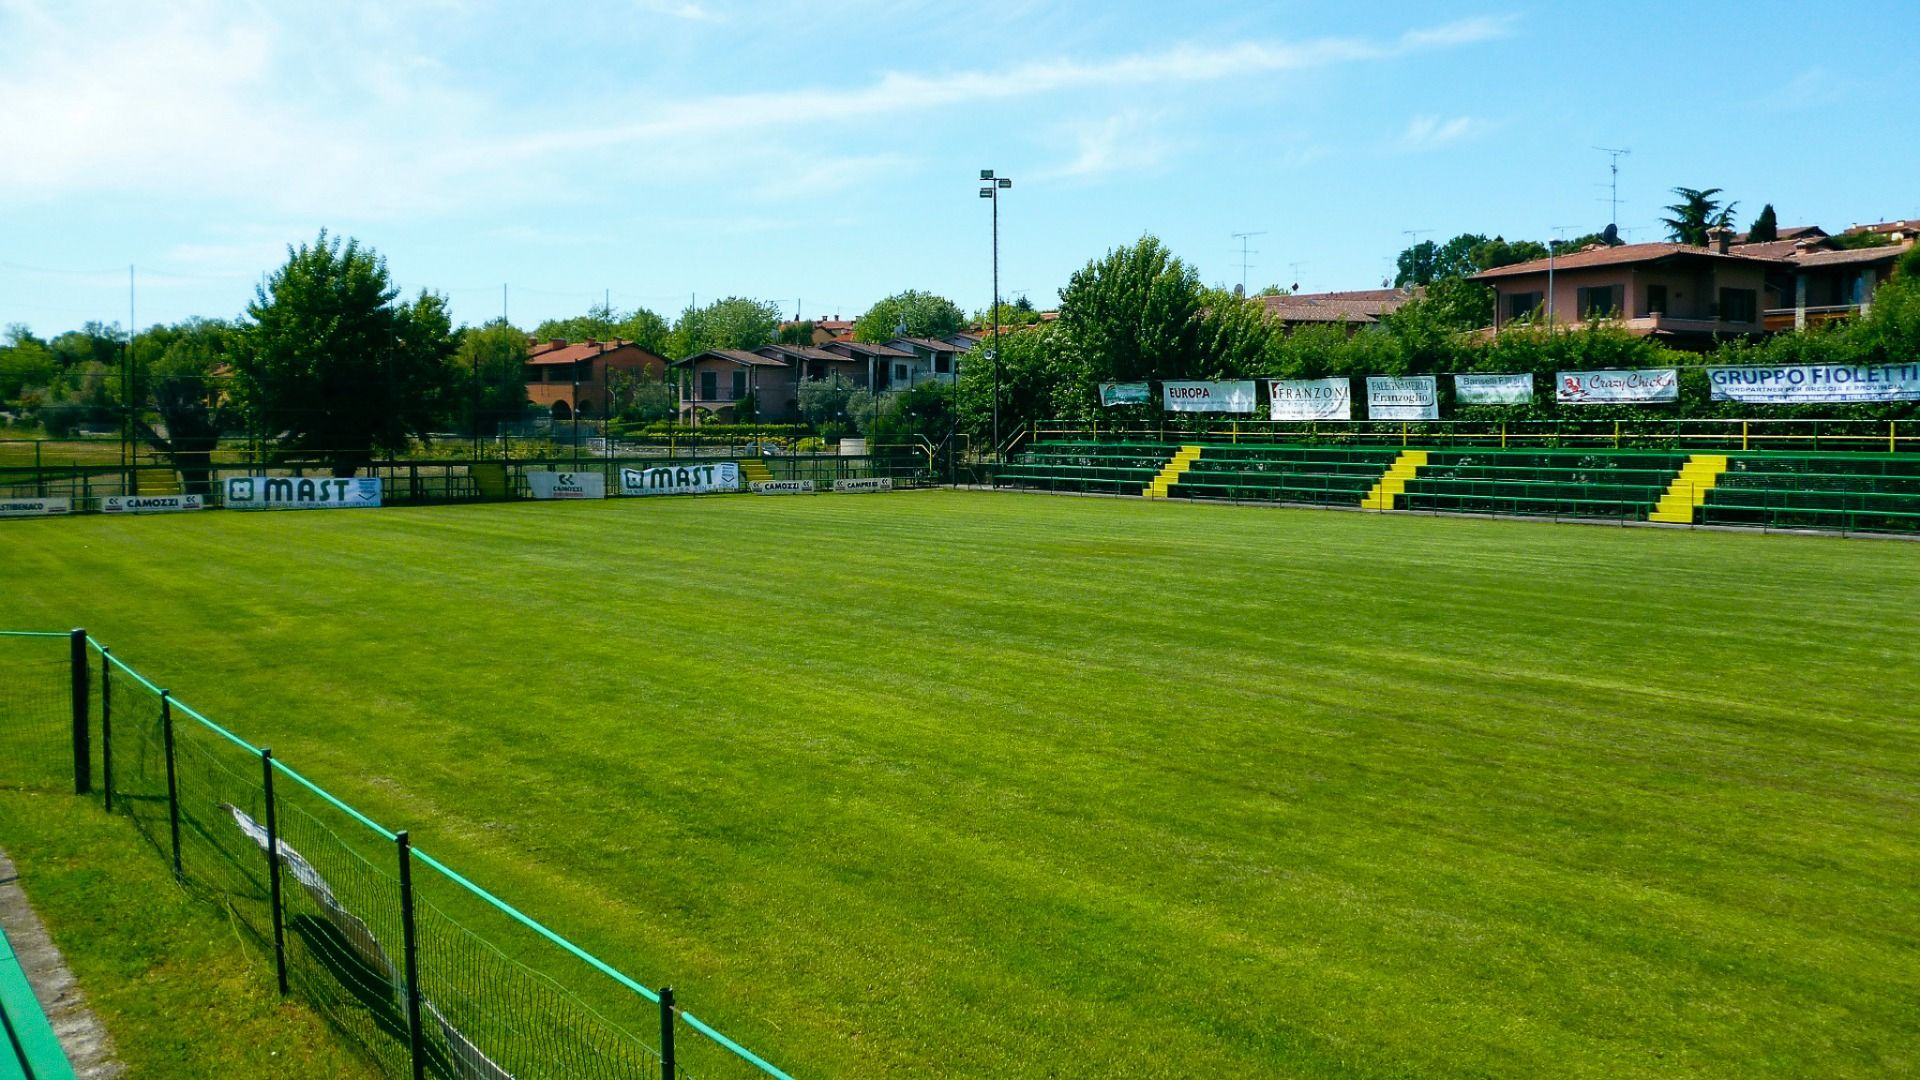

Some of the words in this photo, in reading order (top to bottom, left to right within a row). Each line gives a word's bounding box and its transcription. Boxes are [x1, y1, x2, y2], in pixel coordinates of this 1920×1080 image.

[1712, 369, 1805, 385] GRUPPO
[1812, 364, 1918, 384] FIOLETTI
[1589, 374, 1624, 392] Crazy
[1169, 387, 1210, 399] EUROPA
[1278, 387, 1349, 399] FRANZONI
[1372, 393, 1428, 404] Franzoglio
[650, 465, 716, 489] MAST
[264, 478, 350, 502] MAST
[764, 482, 800, 491] CAMOZZI
[127, 498, 179, 508] CAMOZZI
